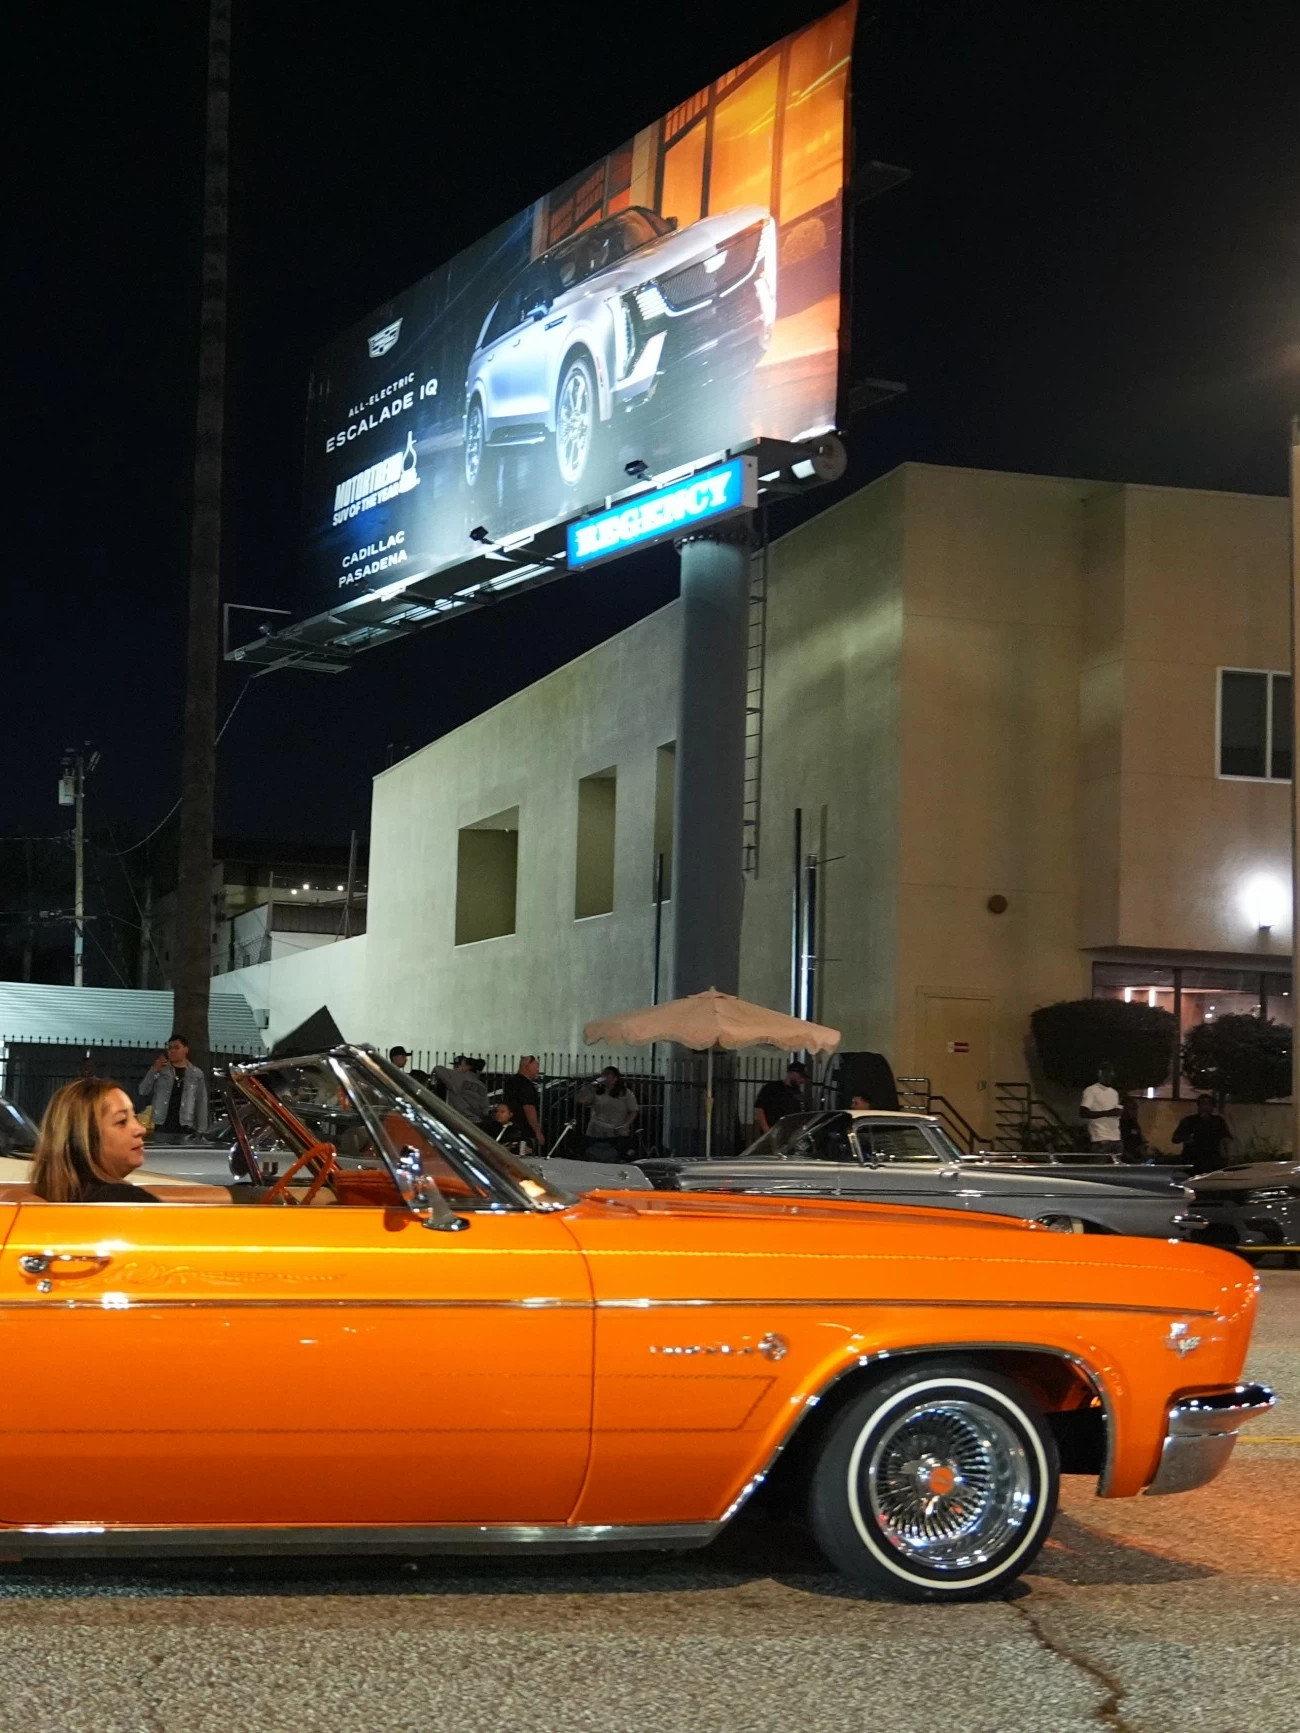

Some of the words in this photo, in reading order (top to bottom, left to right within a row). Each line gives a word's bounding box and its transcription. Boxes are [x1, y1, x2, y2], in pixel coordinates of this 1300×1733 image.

[326, 391, 414, 453] ESCALADE
[419, 378, 438, 400] IQ
[348, 372, 415, 418] ALL-ELECTRIC
[333, 507, 349, 526] SUV
[349, 501, 361, 517] OF
[361, 492, 377, 511] THE
[377, 481, 400, 504] YEAR
[334, 452, 403, 512] MOTORTRE
[575, 470, 732, 557] REGENCY
[338, 549, 408, 588] PASADENA
[342, 530, 405, 568] CADILLAC
